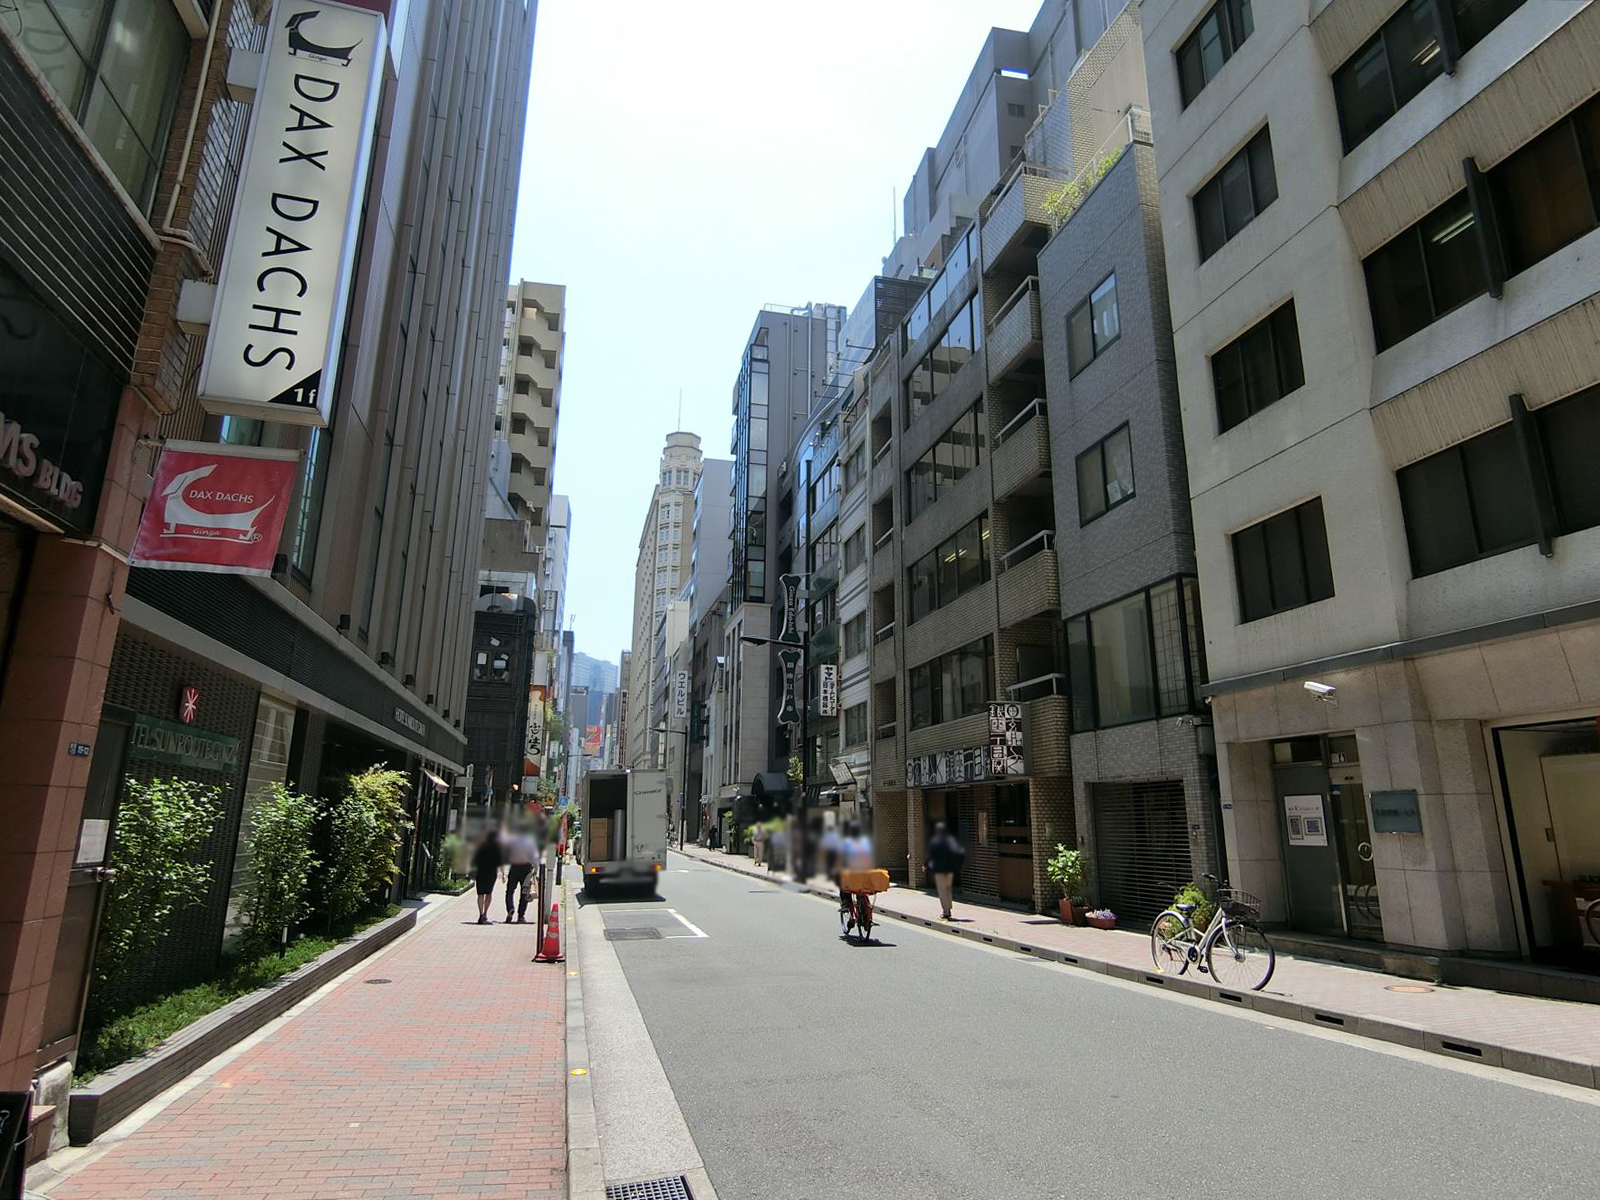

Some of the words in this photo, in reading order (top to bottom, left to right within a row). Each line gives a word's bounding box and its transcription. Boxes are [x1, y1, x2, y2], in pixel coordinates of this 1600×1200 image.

[279, 73, 340, 171] DAX
[242, 192, 320, 372] DACHS
[293, 387, 318, 404] 1f
[37, 458, 84, 508] BLDG
[189, 489, 214, 501] DAX
[215, 490, 254, 504] DACHS
[192, 528, 222, 537] Ginza
